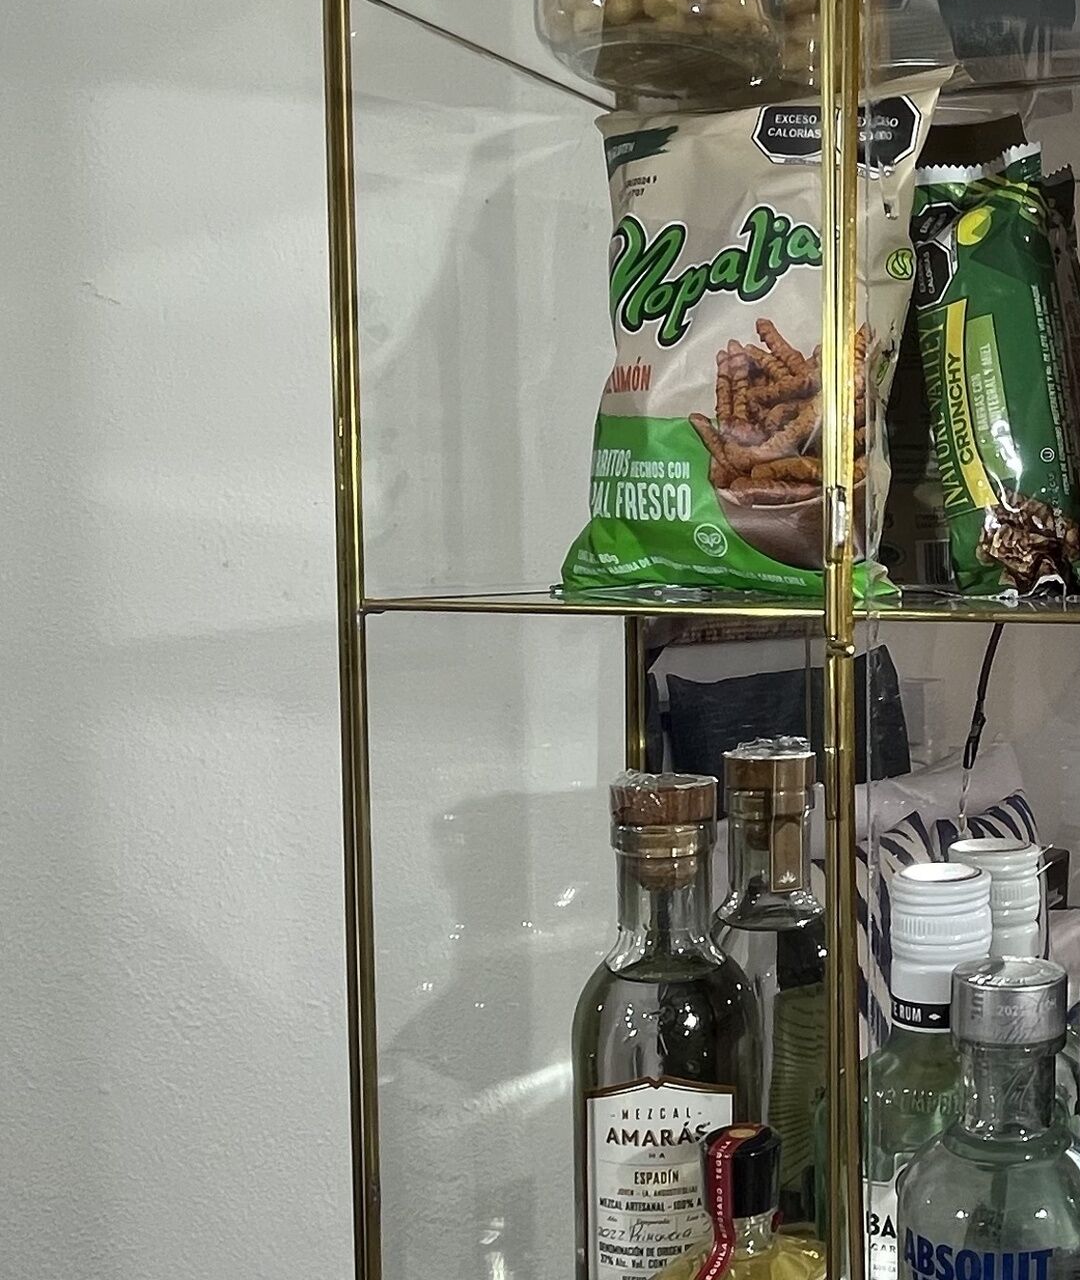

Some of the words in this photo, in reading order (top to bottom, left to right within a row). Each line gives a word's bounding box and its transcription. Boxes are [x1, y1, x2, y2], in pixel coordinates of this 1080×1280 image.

[775, 113, 818, 125] EXCESO
[767, 126, 822, 139] CALORÍAS
[947, 352, 975, 466] CRUNCHY
[667, 461, 690, 479] CON
[615, 481, 692, 522] FRESCO
[900, 1006, 923, 1023] RUM
[621, 1107, 692, 1120] MEZCAL
[606, 1120, 711, 1147] AMARÁS
[634, 1168, 680, 1185] ESPADÍN
[625, 1201, 665, 1212] ARTESANAL
